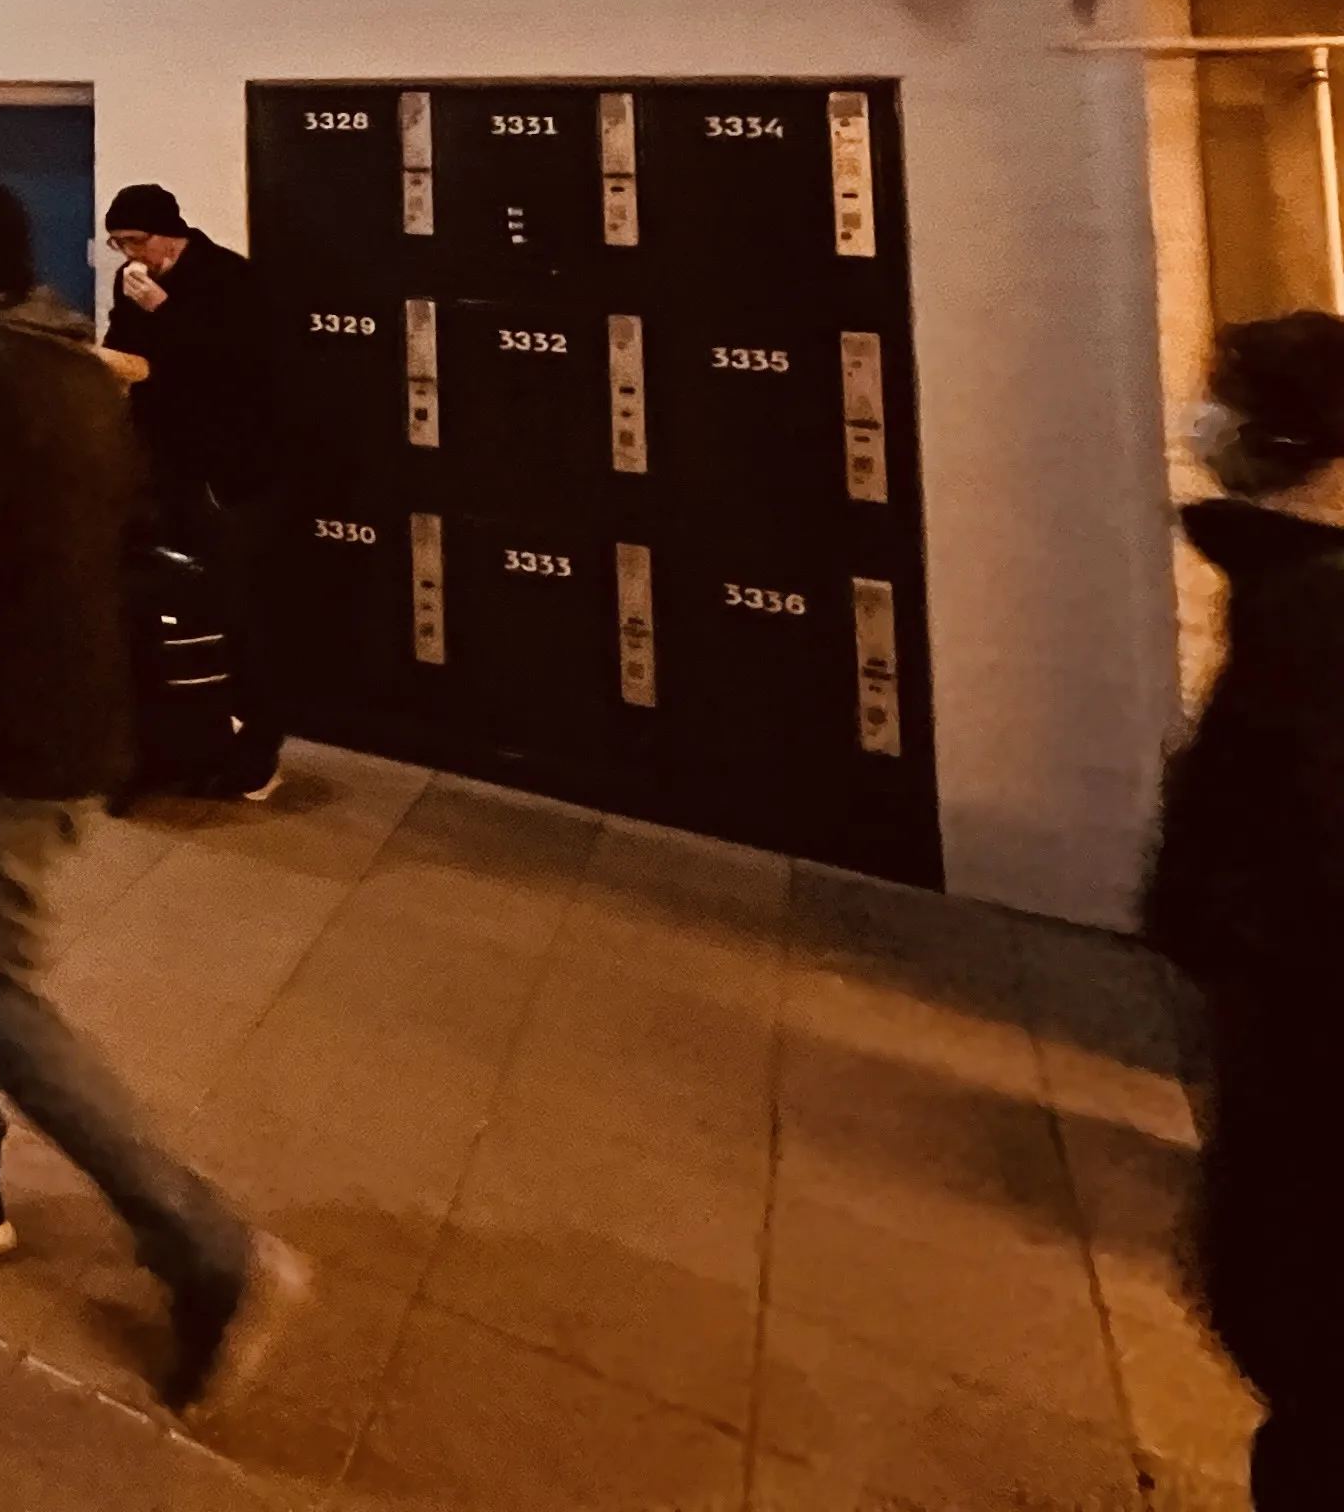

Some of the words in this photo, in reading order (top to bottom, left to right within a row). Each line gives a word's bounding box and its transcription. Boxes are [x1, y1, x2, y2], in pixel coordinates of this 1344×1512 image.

[305, 111, 369, 130] 3328
[491, 115, 557, 135] 3331
[705, 116, 784, 138] 3334
[310, 313, 376, 335] 3329
[498, 329, 567, 353] 3332
[712, 347, 790, 373] 3335
[315, 518, 377, 544] 3330
[504, 549, 571, 577] 3333
[724, 583, 806, 615] 3336
